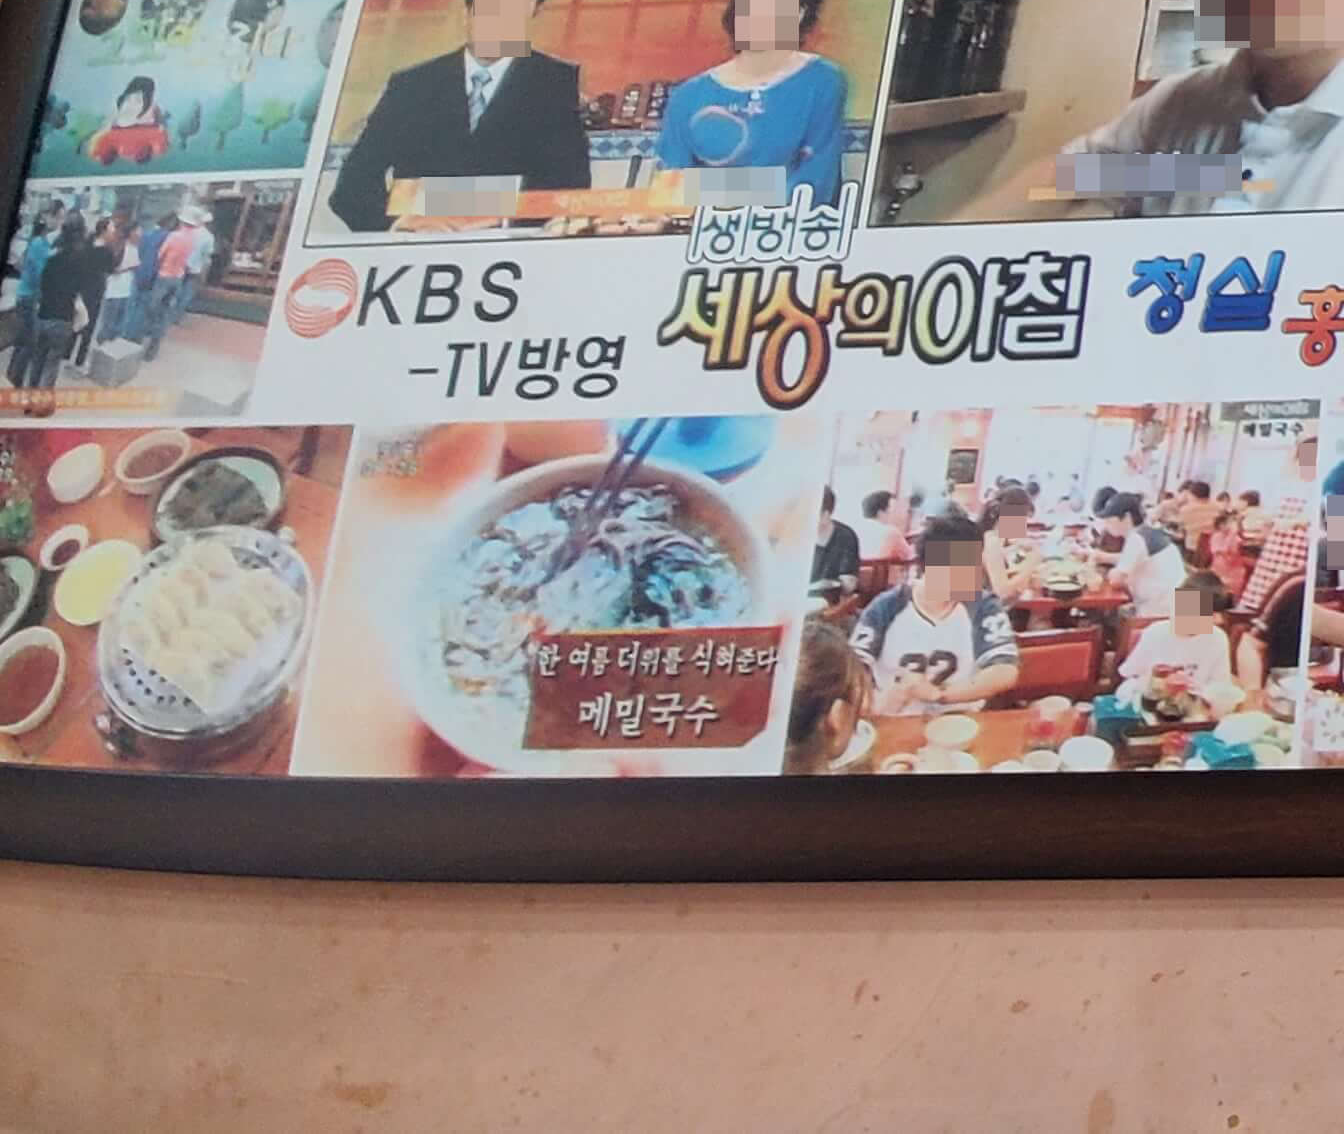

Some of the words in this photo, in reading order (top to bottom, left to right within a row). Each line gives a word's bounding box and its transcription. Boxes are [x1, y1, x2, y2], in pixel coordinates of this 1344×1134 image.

[687, 182, 860, 264] 생방송
[358, 262, 524, 327] KBS
[656, 251, 1093, 411] 세상의아침
[569, 642, 610, 676] 여름
[618, 641, 684, 677] 더위를
[692, 638, 779, 675] 식혀준다
[579, 691, 719, 738] 메밀국수
